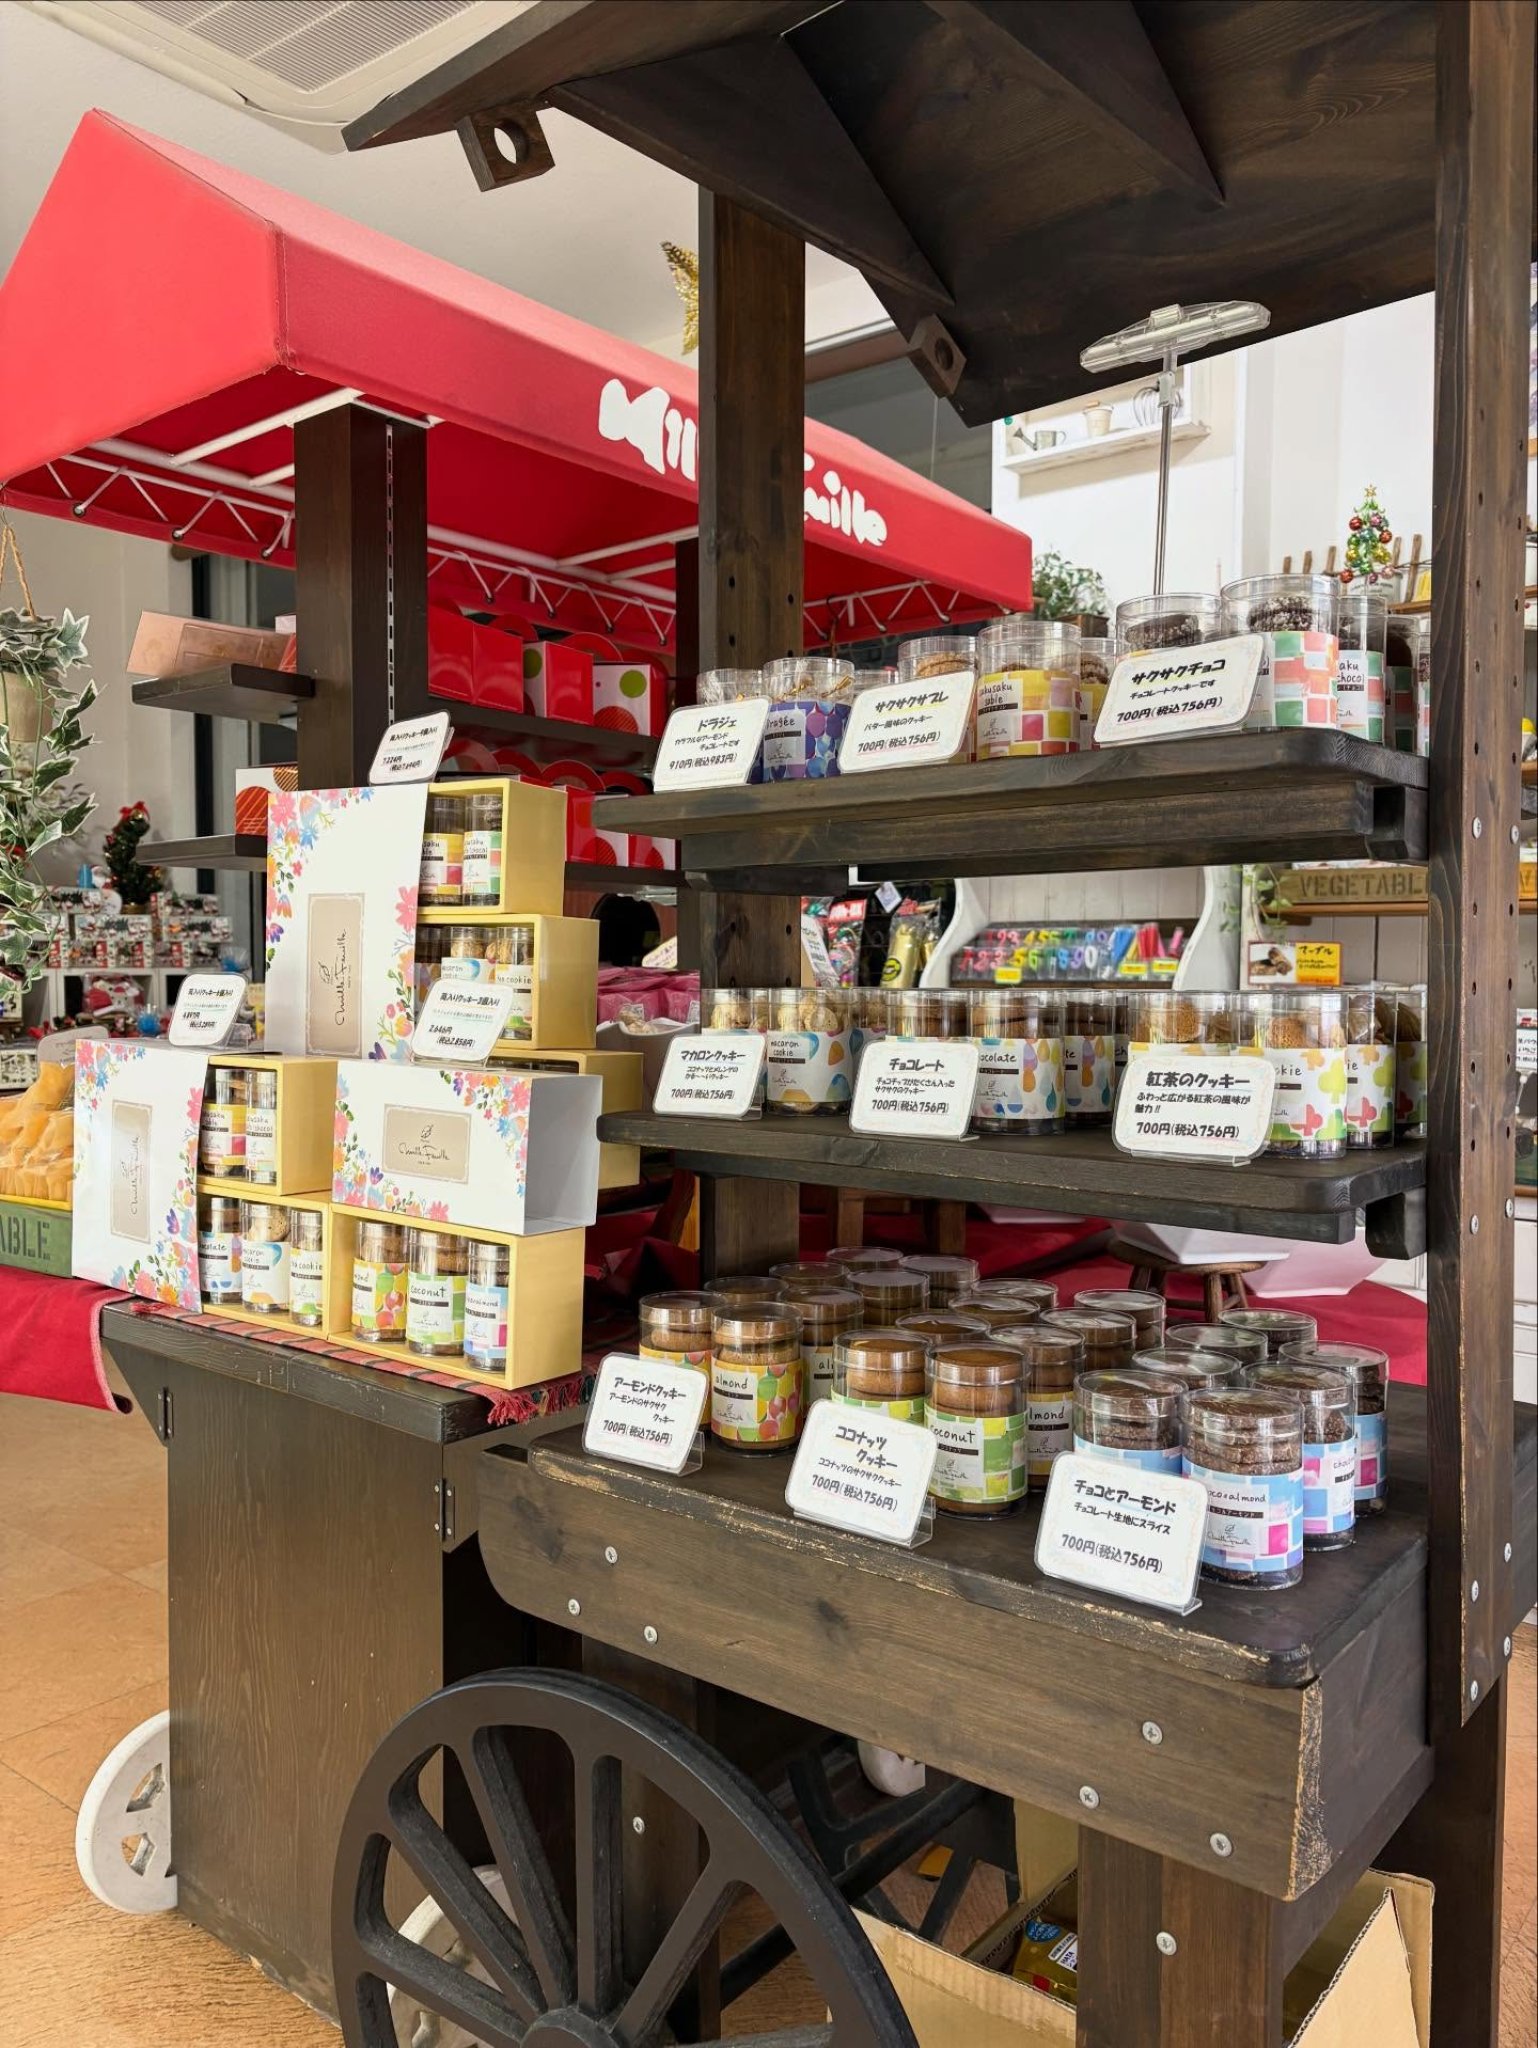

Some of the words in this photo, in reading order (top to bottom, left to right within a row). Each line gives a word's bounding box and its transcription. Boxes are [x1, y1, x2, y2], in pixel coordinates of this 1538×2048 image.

[1132, 658, 1226, 685] サクサクチョコ
[980, 682, 1013, 695] akusaku
[1130, 679, 1217, 700] チョコレートクッキーです
[875, 691, 949, 713] サクサクサブレ
[1116, 696, 1223, 723] 700円(税込756円)
[698, 716, 737, 732] ドラジェ
[858, 731, 941, 753] 700円(税込756円)
[1301, 874, 1428, 898] VEGETABL
[680, 1050, 746, 1061] マカロンクッキー
[889, 1057, 945, 1072] チョコレート
[980, 1052, 1017, 1063] ocolate
[1145, 1070, 1251, 1089] 紅茶のクッキー
[671, 1089, 735, 1100] 700円(税込756円)
[874, 1085, 926, 1095] サクサクのクッキー
[1136, 1091, 1251, 1106] ふわっと広がる紅茶の風味が
[871, 1099, 950, 1114] 700円(税込756円)
[1136, 1121, 1240, 1139] 700円(税込756円)
[410, 1286, 446, 1298] coconut
[614, 1376, 687, 1400] アーモンドクッキー
[716, 1374, 748, 1389] almond
[609, 1392, 667, 1411] アーモンドのサクサク
[653, 1413, 675, 1424] クッキー
[1029, 1405, 1065, 1420] lmond
[602, 1420, 673, 1445] 700円(税込756円)
[835, 1425, 887, 1450] ココナッツ
[856, 1448, 898, 1468] クッキー
[818, 1457, 902, 1487] ココナッツのサクサククッキー
[811, 1474, 898, 1512] 700円(税込756円)
[1074, 1479, 1177, 1516] チョコとアーモンド
[1074, 1502, 1171, 1535] チョコレート生地にスライス
[1061, 1534, 1163, 1573] 700円(税込756円)
